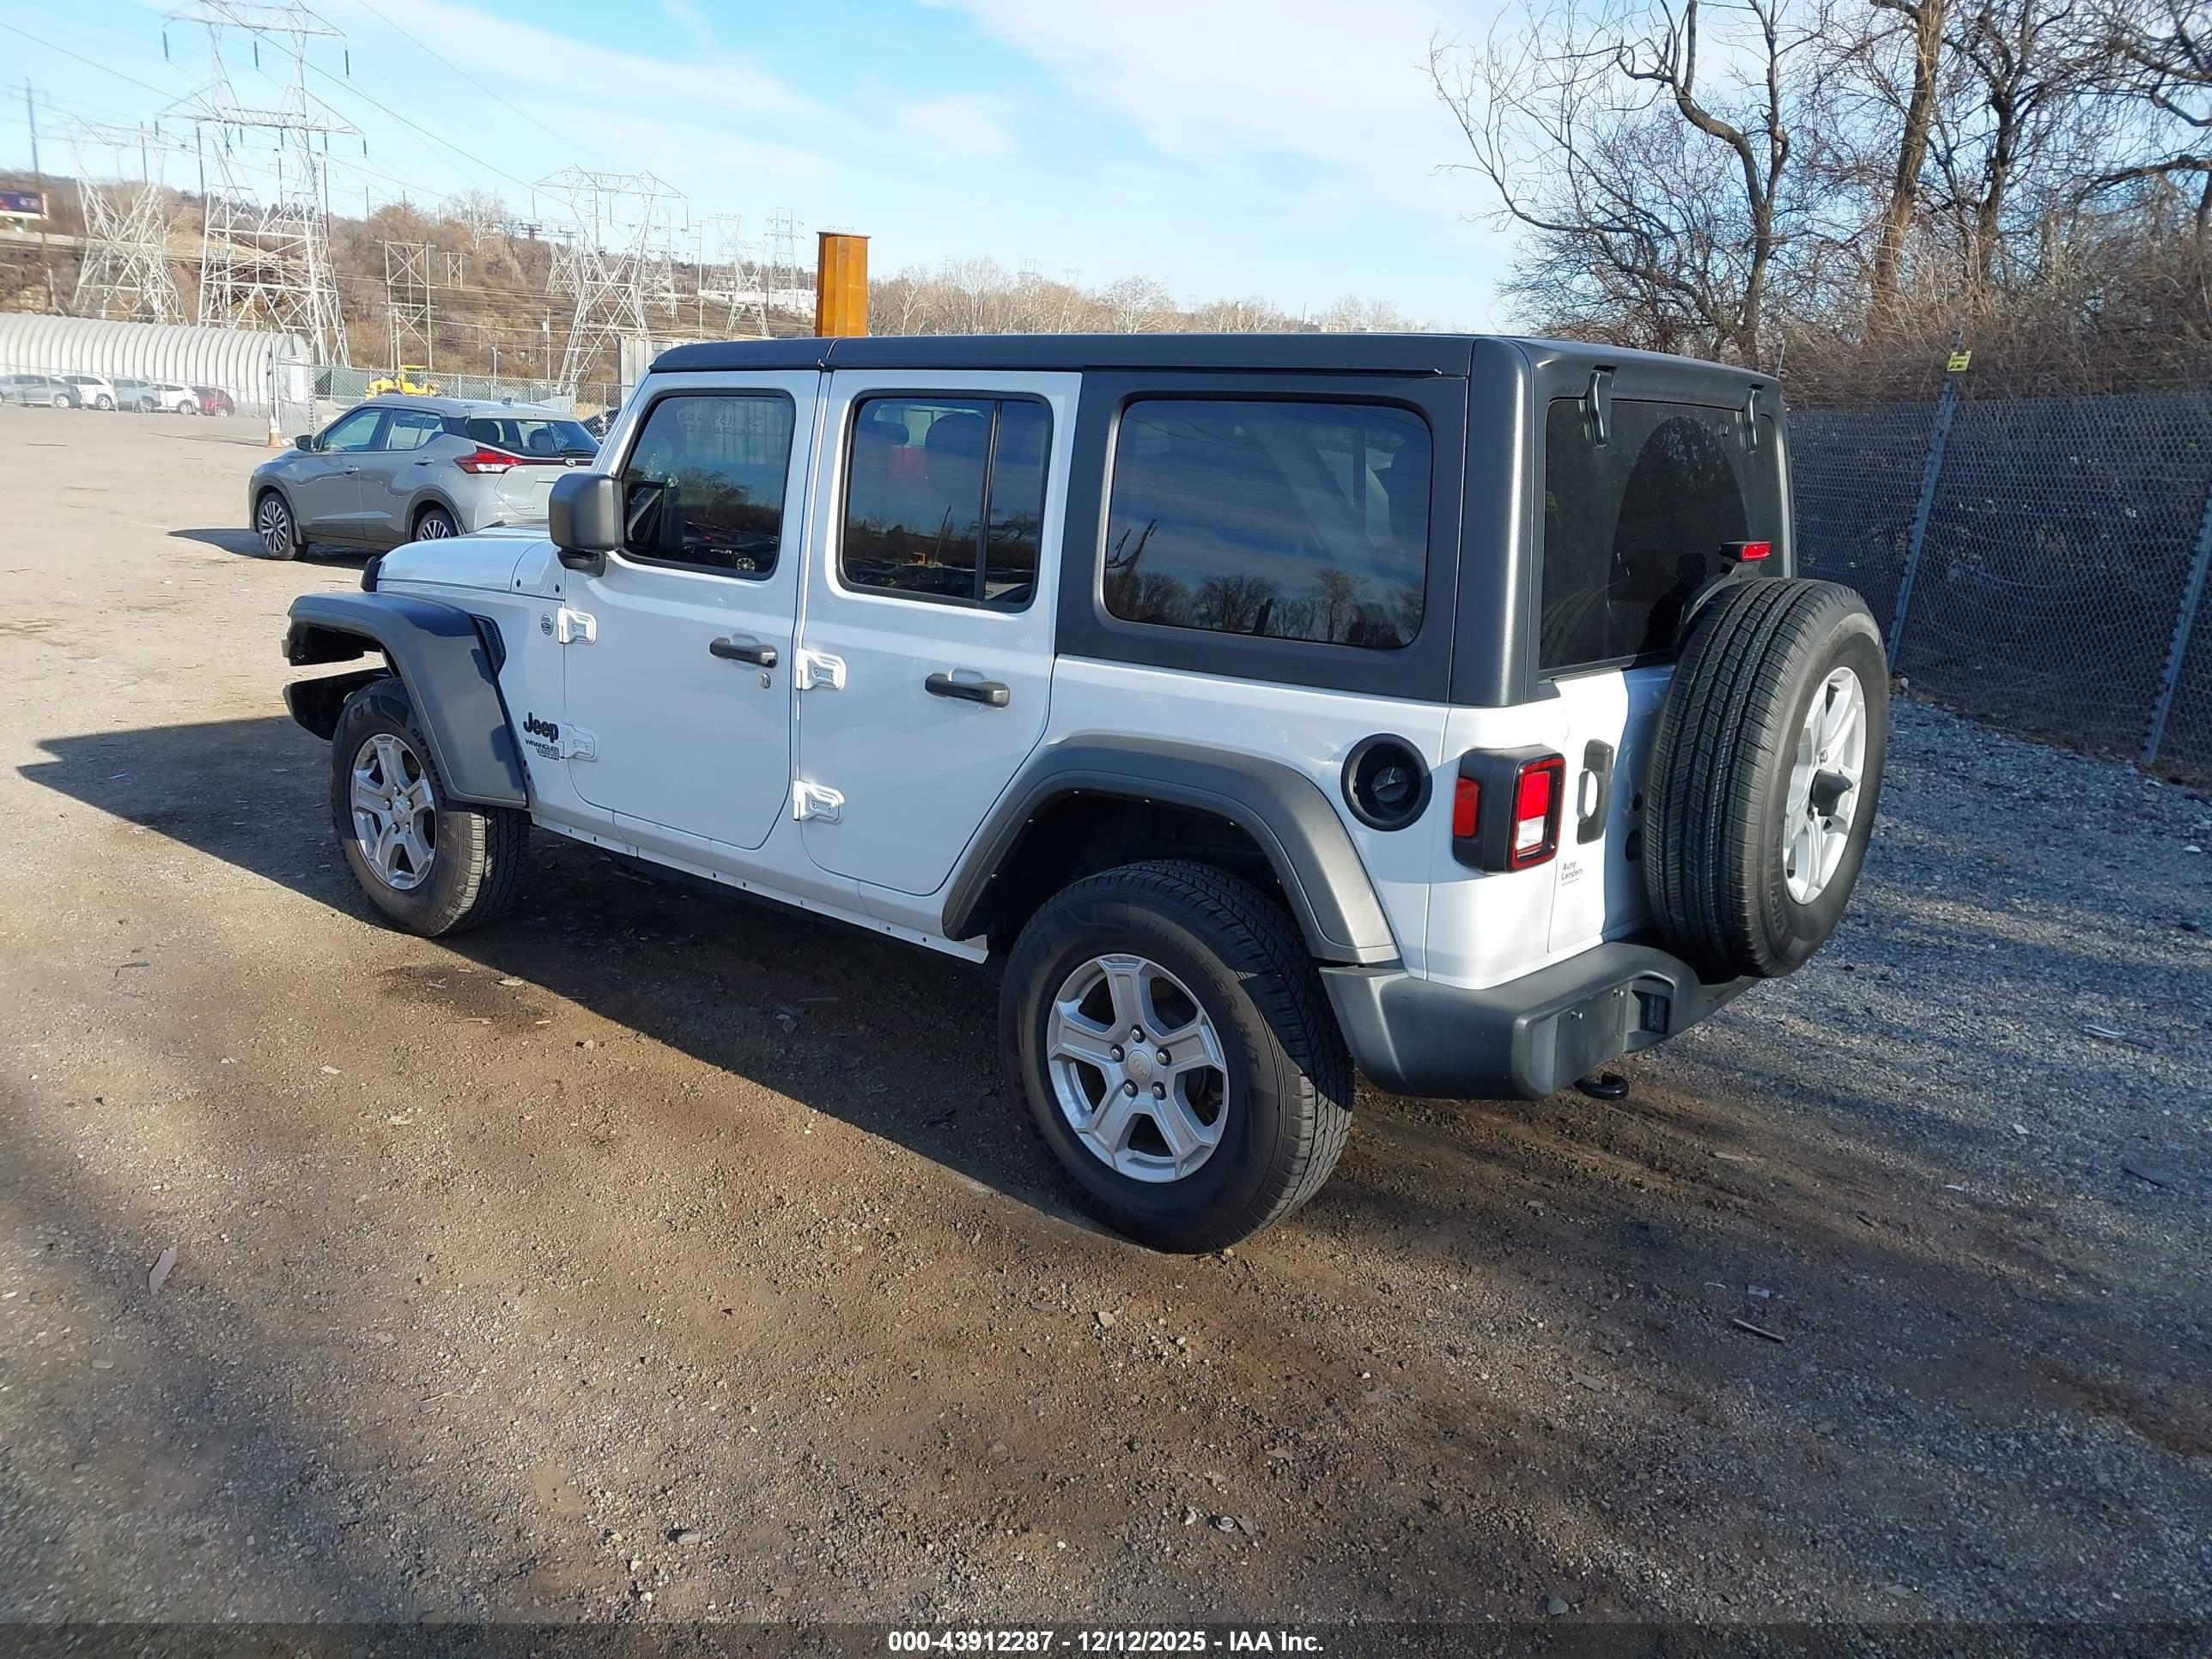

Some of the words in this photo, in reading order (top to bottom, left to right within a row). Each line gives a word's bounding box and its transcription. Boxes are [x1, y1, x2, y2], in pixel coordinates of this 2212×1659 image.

[523, 711, 559, 744] Jeep
[524, 738, 560, 753] WRANGLER
[1562, 861, 1577, 871] Auto
